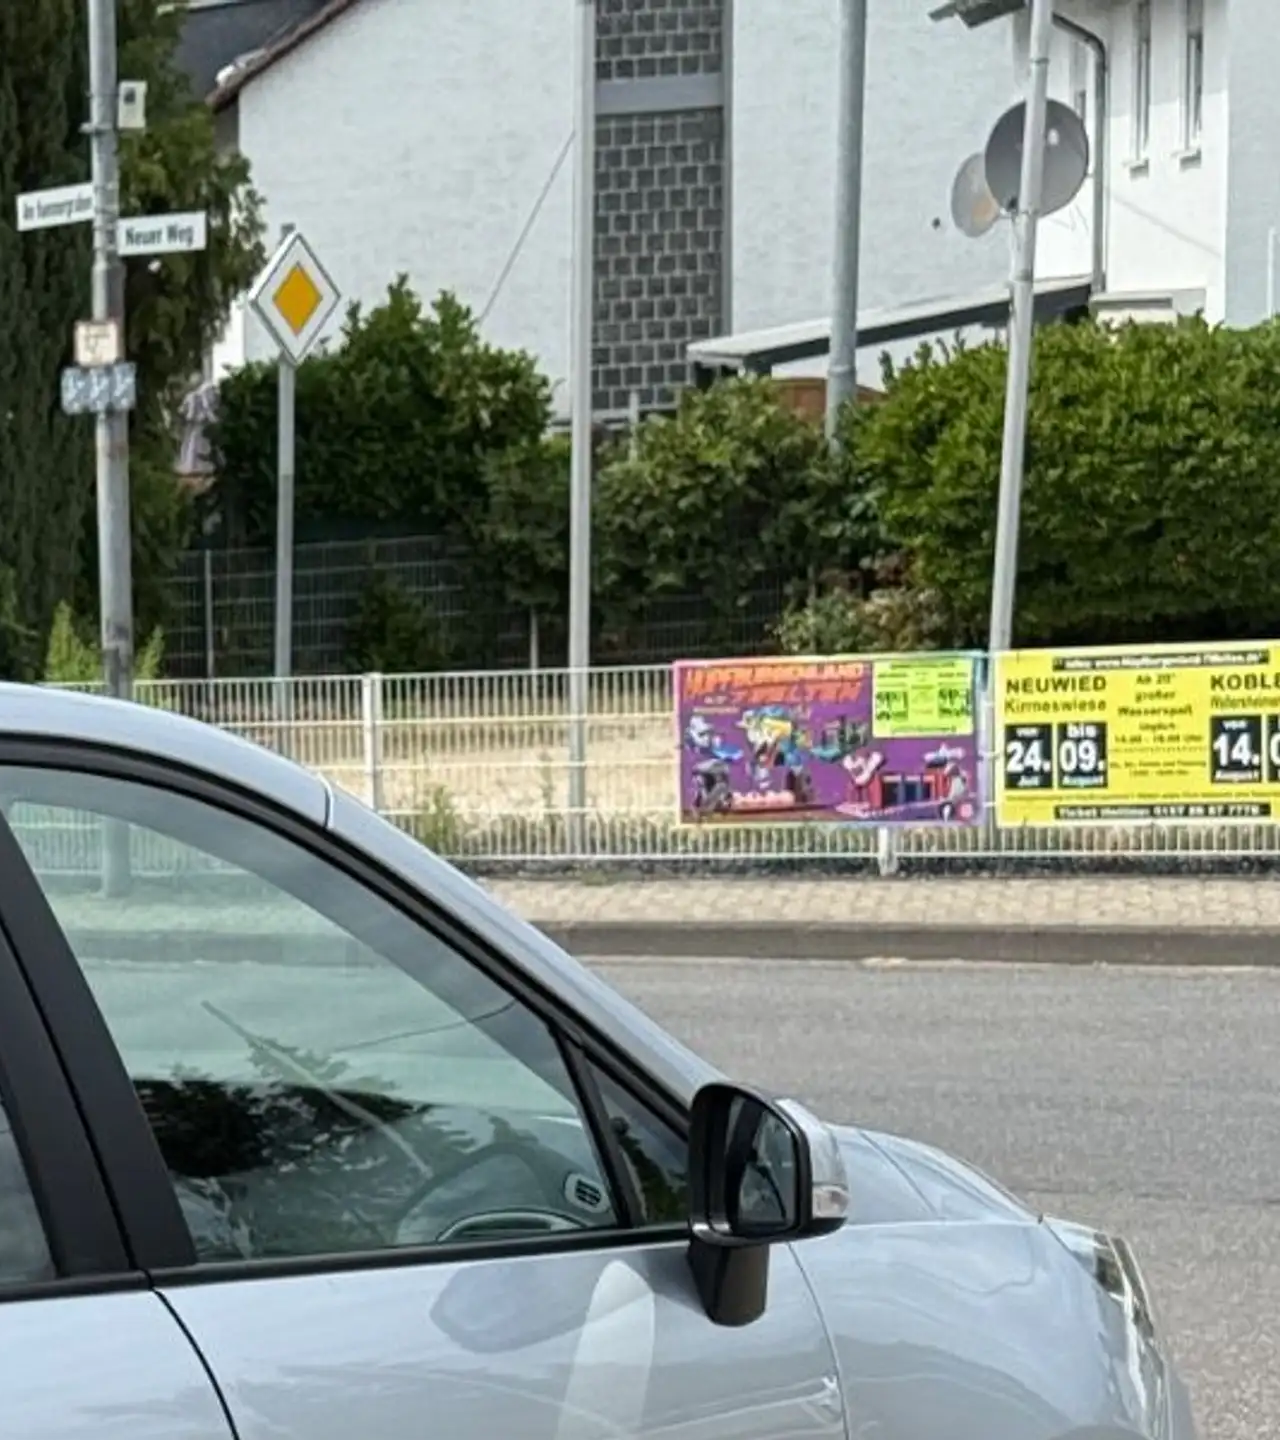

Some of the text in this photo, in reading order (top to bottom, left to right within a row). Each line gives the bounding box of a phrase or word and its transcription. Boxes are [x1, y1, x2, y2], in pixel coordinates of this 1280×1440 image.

[125, 224, 195, 247] Neuer Weg
[1006, 676, 1107, 694] NEUWIED
[1005, 699, 1107, 713] Kirmeswiese
[1066, 722, 1097, 738] bis
[1006, 740, 1052, 773] 24.
[1059, 740, 1105, 772] 09.
[1213, 732, 1260, 767] 14.
